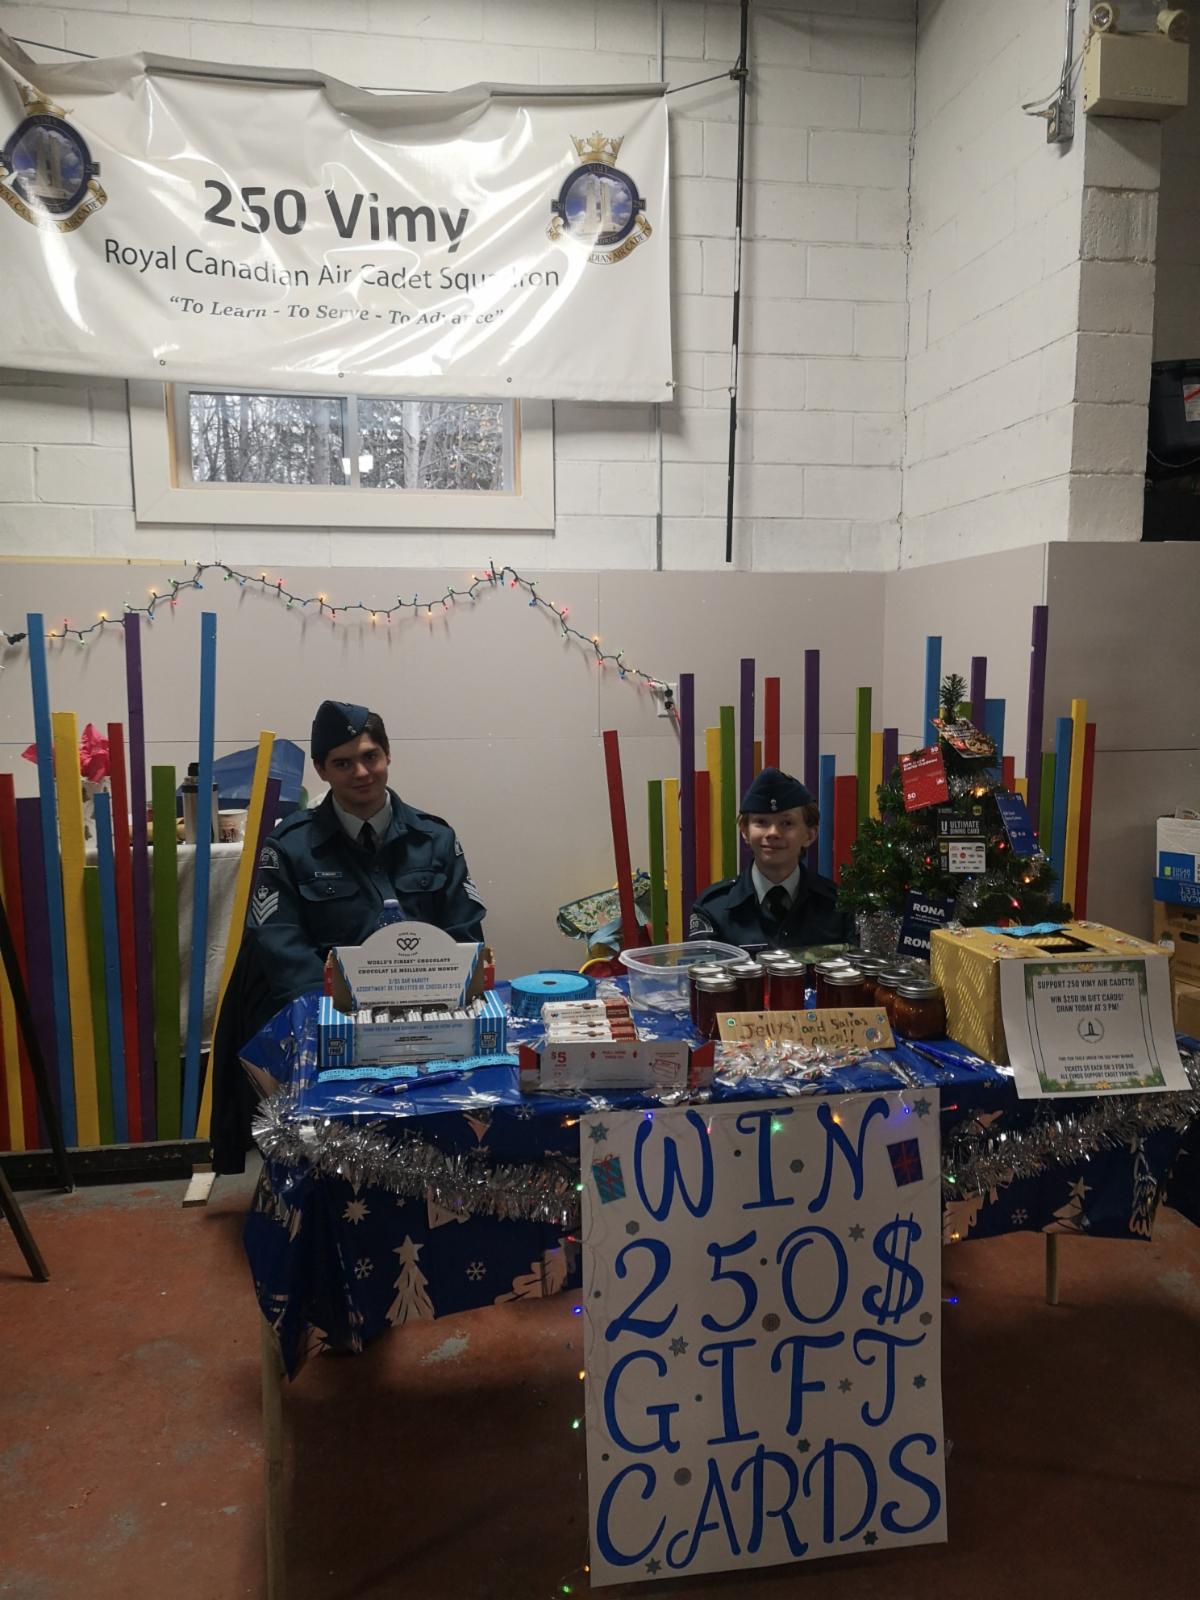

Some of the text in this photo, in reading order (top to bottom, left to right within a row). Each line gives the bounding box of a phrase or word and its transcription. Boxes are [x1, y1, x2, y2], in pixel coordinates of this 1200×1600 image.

[204, 179, 470, 253] 250 Vimy
[105, 239, 560, 294] Royal Canadian Air Cadet Squron
[209, 301, 267, 318] Learn
[287, 304, 310, 318] To
[315, 305, 369, 320] Serve
[389, 310, 410, 325] To
[416, 308, 504, 325] Adace”
[907, 792, 916, 800] 50
[949, 820, 980, 828] ULTIMATE
[912, 902, 945, 917] RONA
[903, 935, 931, 950] RON
[1038, 978, 1134, 989] SUPPORT 250 VIMY AIR CADETS!
[1063, 995, 1078, 1003] $250
[1102, 993, 1124, 1001] CARDS!
[1057, 1005, 1073, 1013] DRAW
[1075, 1004, 1092, 1012] TODAY
[801, 1021, 825, 1034] and
[634, 1097, 890, 1222] WIN
[604, 1212, 924, 1342] 250$
[603, 1328, 927, 1454] GIFT
[596, 1432, 942, 1570] CARDS
